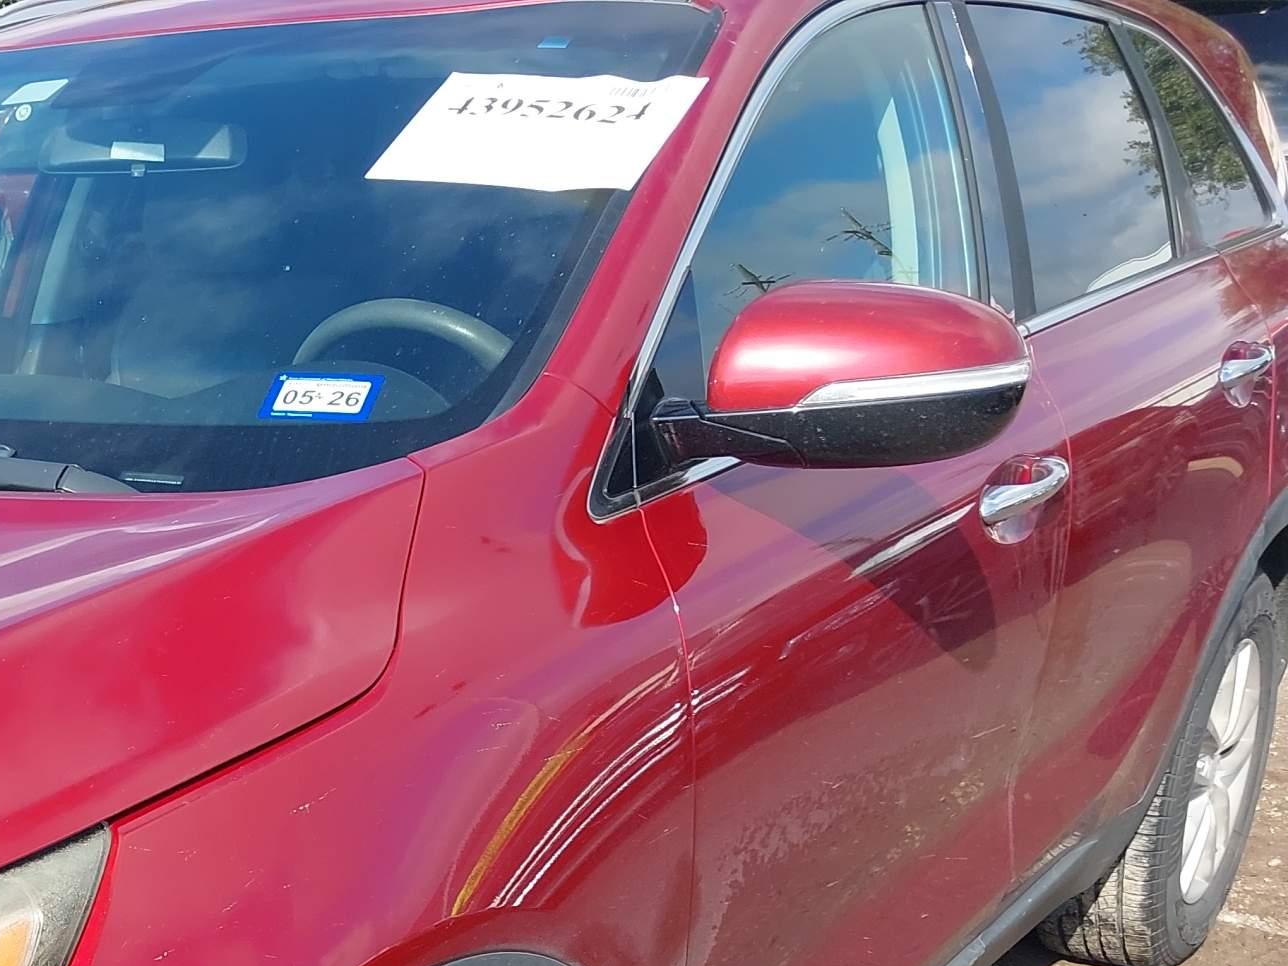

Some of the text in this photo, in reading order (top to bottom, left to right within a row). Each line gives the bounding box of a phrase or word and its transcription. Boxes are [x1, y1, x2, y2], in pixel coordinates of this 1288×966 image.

[448, 96, 652, 124] 43952624
[283, 390, 362, 407] 05 26
